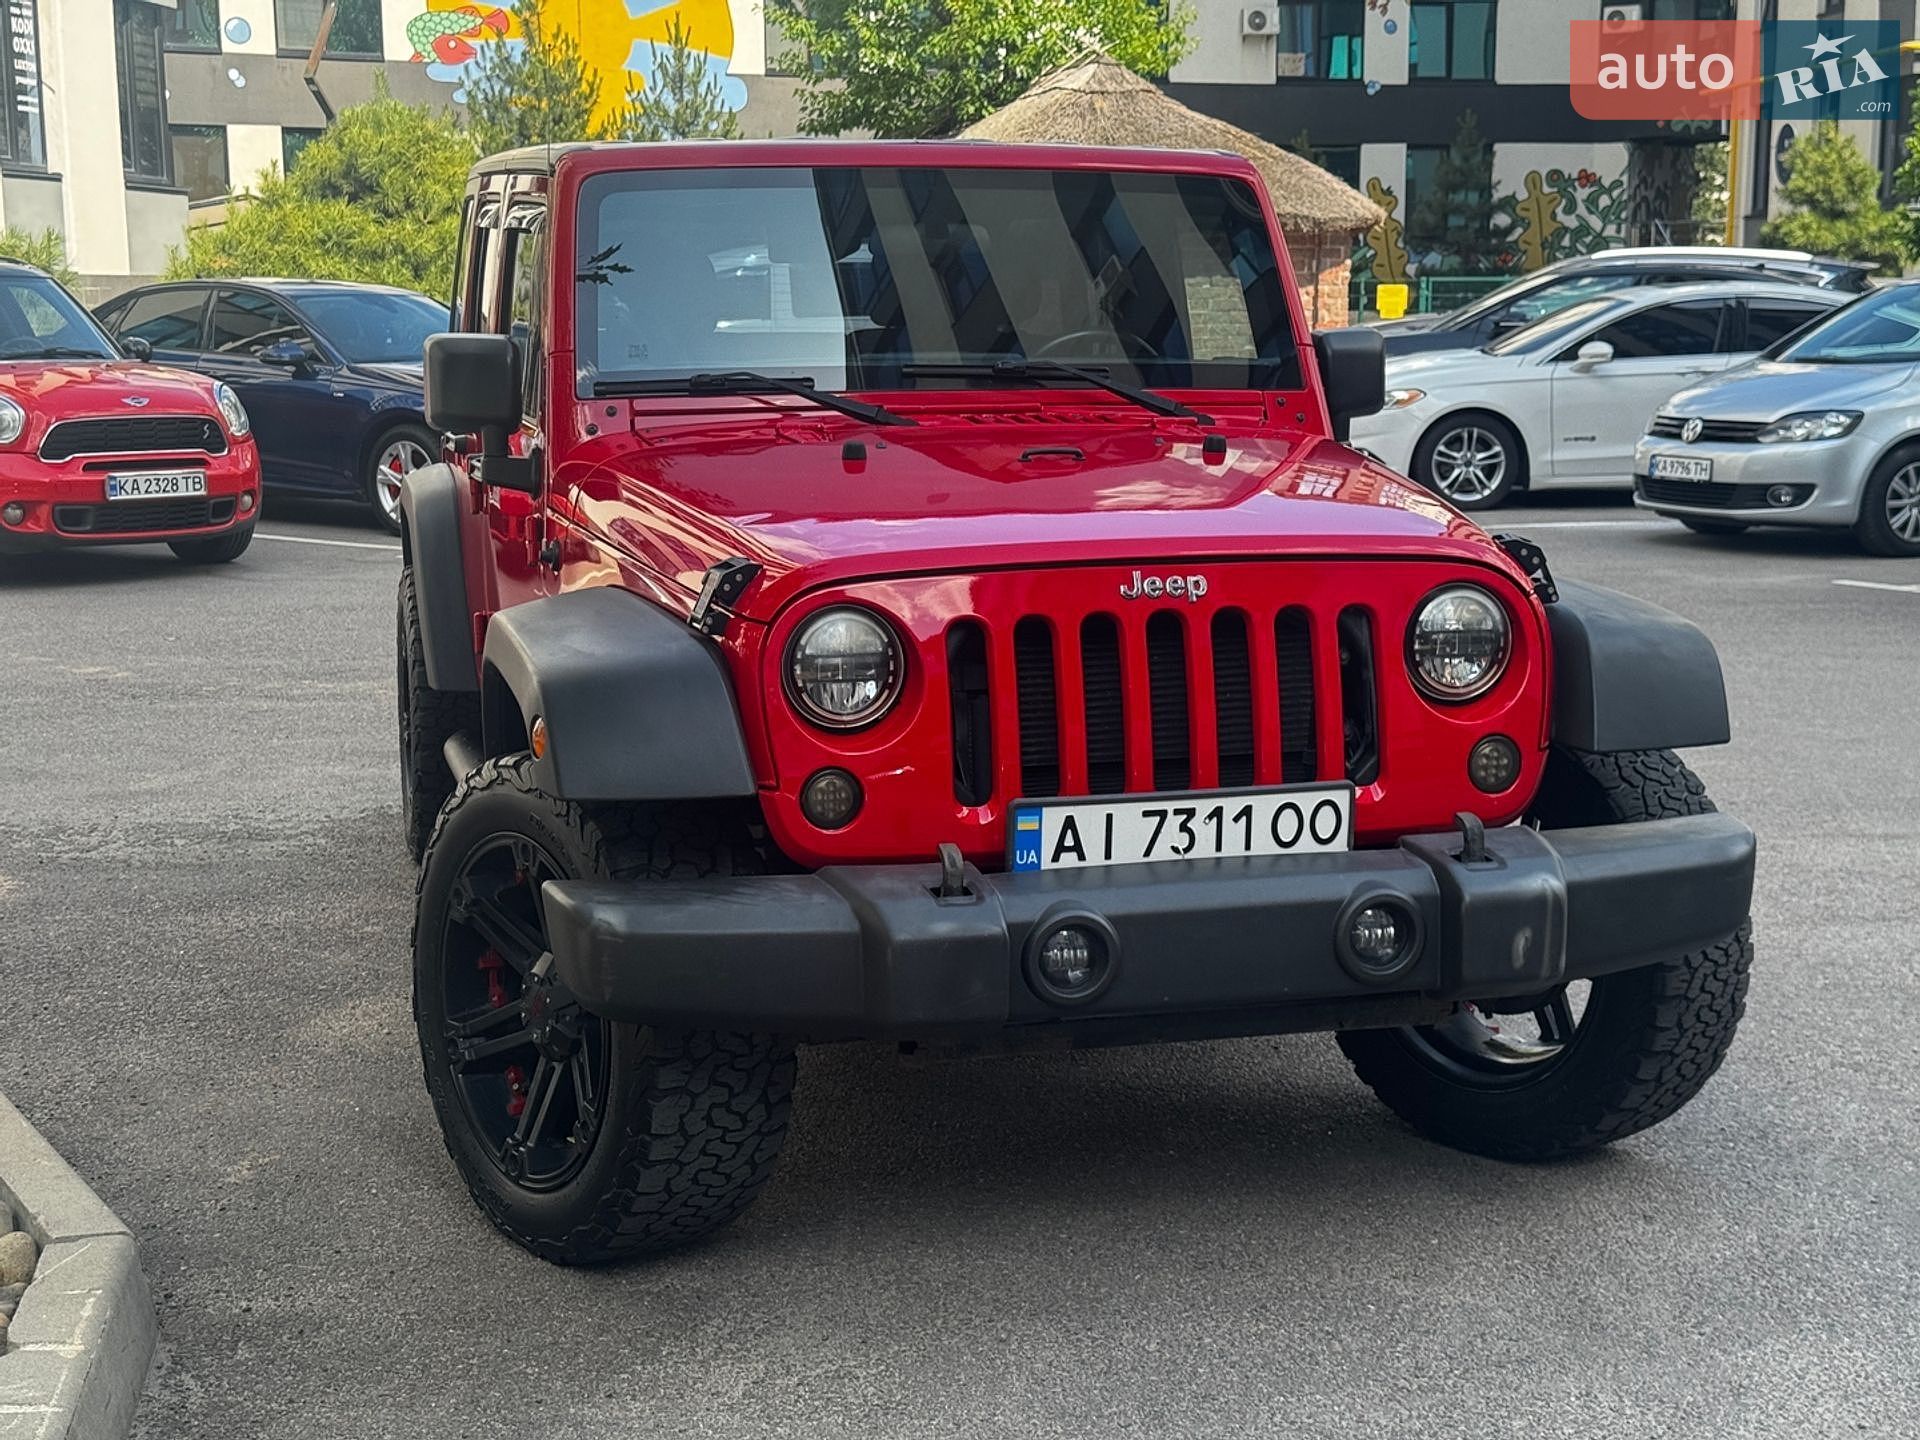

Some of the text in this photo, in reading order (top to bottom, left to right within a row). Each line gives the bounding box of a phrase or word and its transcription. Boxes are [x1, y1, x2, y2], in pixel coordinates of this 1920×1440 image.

[118, 475, 203, 496] KA 2328 TB
[1120, 571, 1208, 602] Jeep
[1051, 799, 1342, 863] AI 7311 OO
[1016, 849, 1038, 865] UA
